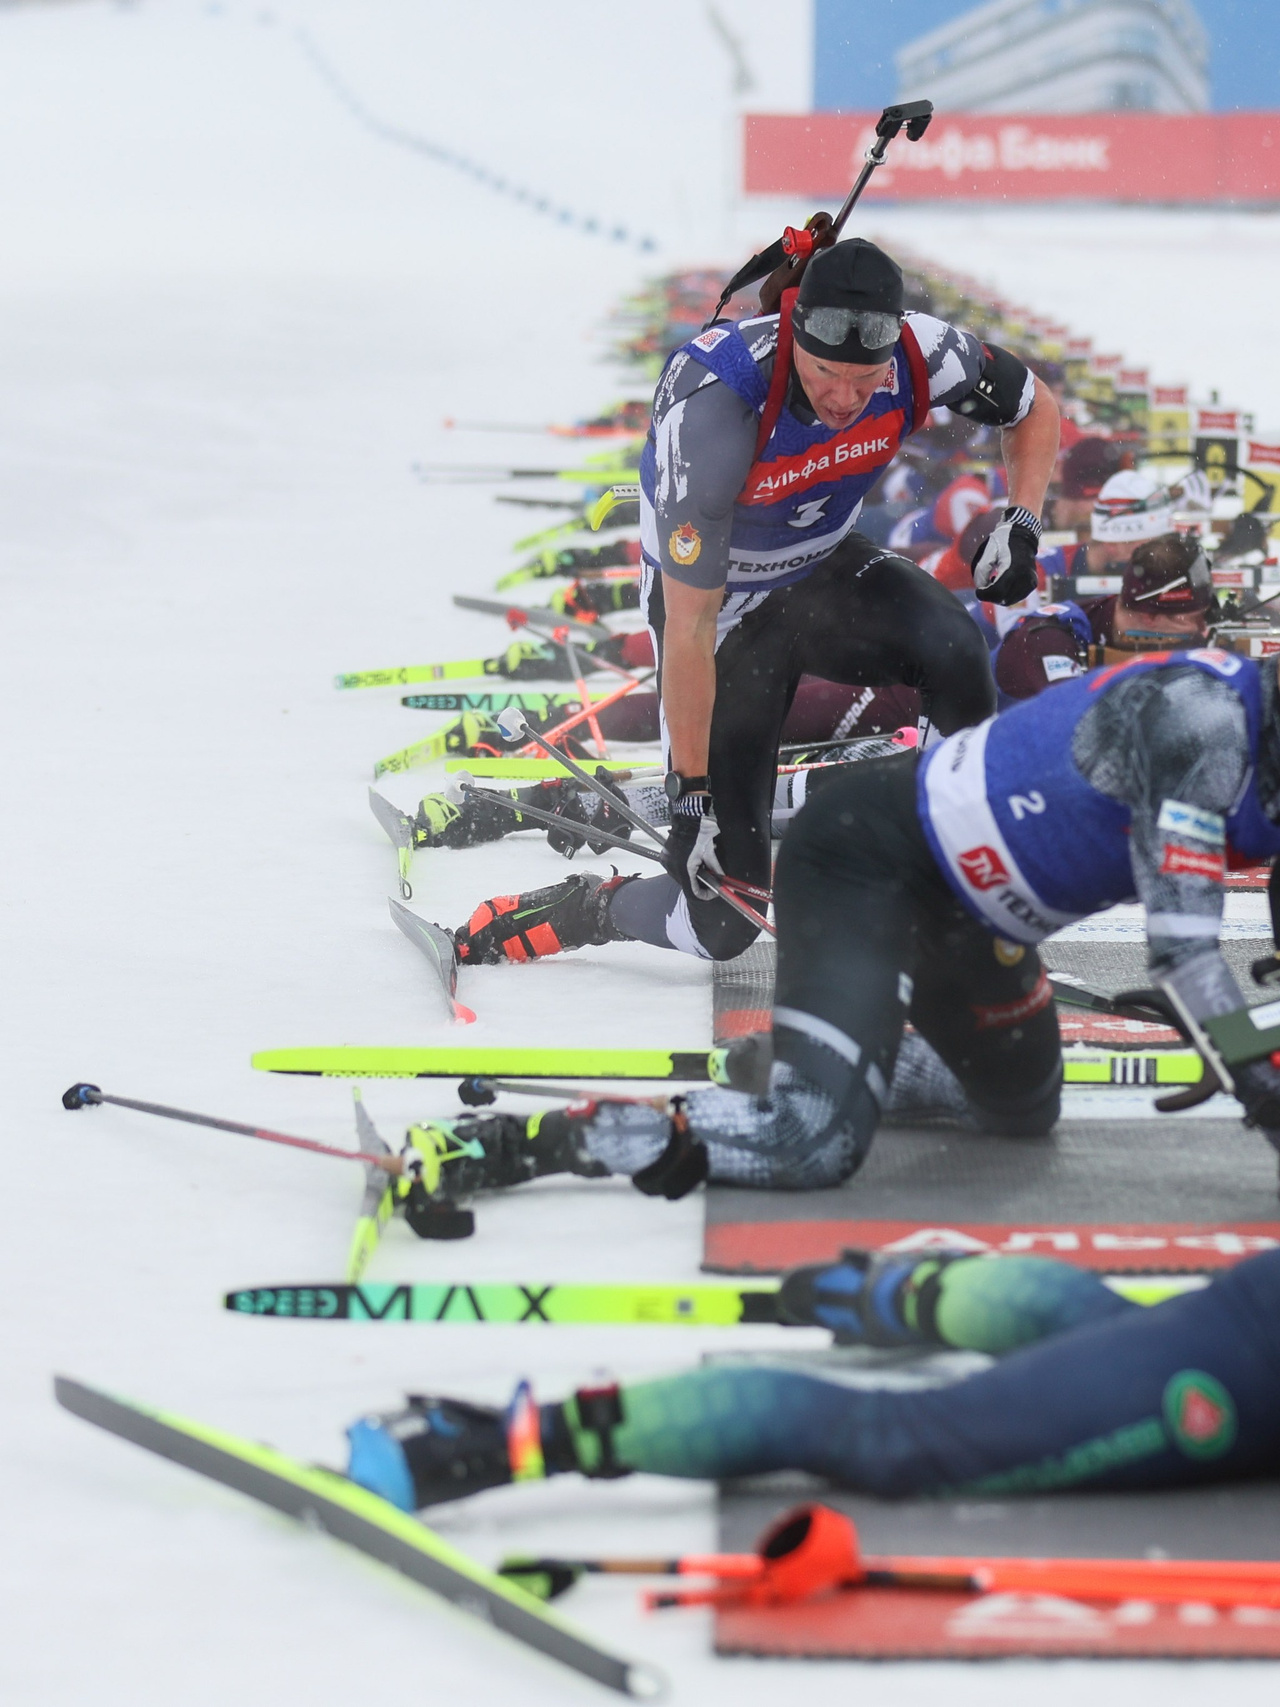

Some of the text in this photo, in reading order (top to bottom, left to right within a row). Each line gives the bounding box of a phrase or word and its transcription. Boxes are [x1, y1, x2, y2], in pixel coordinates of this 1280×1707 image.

[753, 436, 890, 499] Альфа Банк
[787, 494, 832, 528] 3
[1008, 789, 1047, 821] 2
[235, 1287, 339, 1318] SPEED
